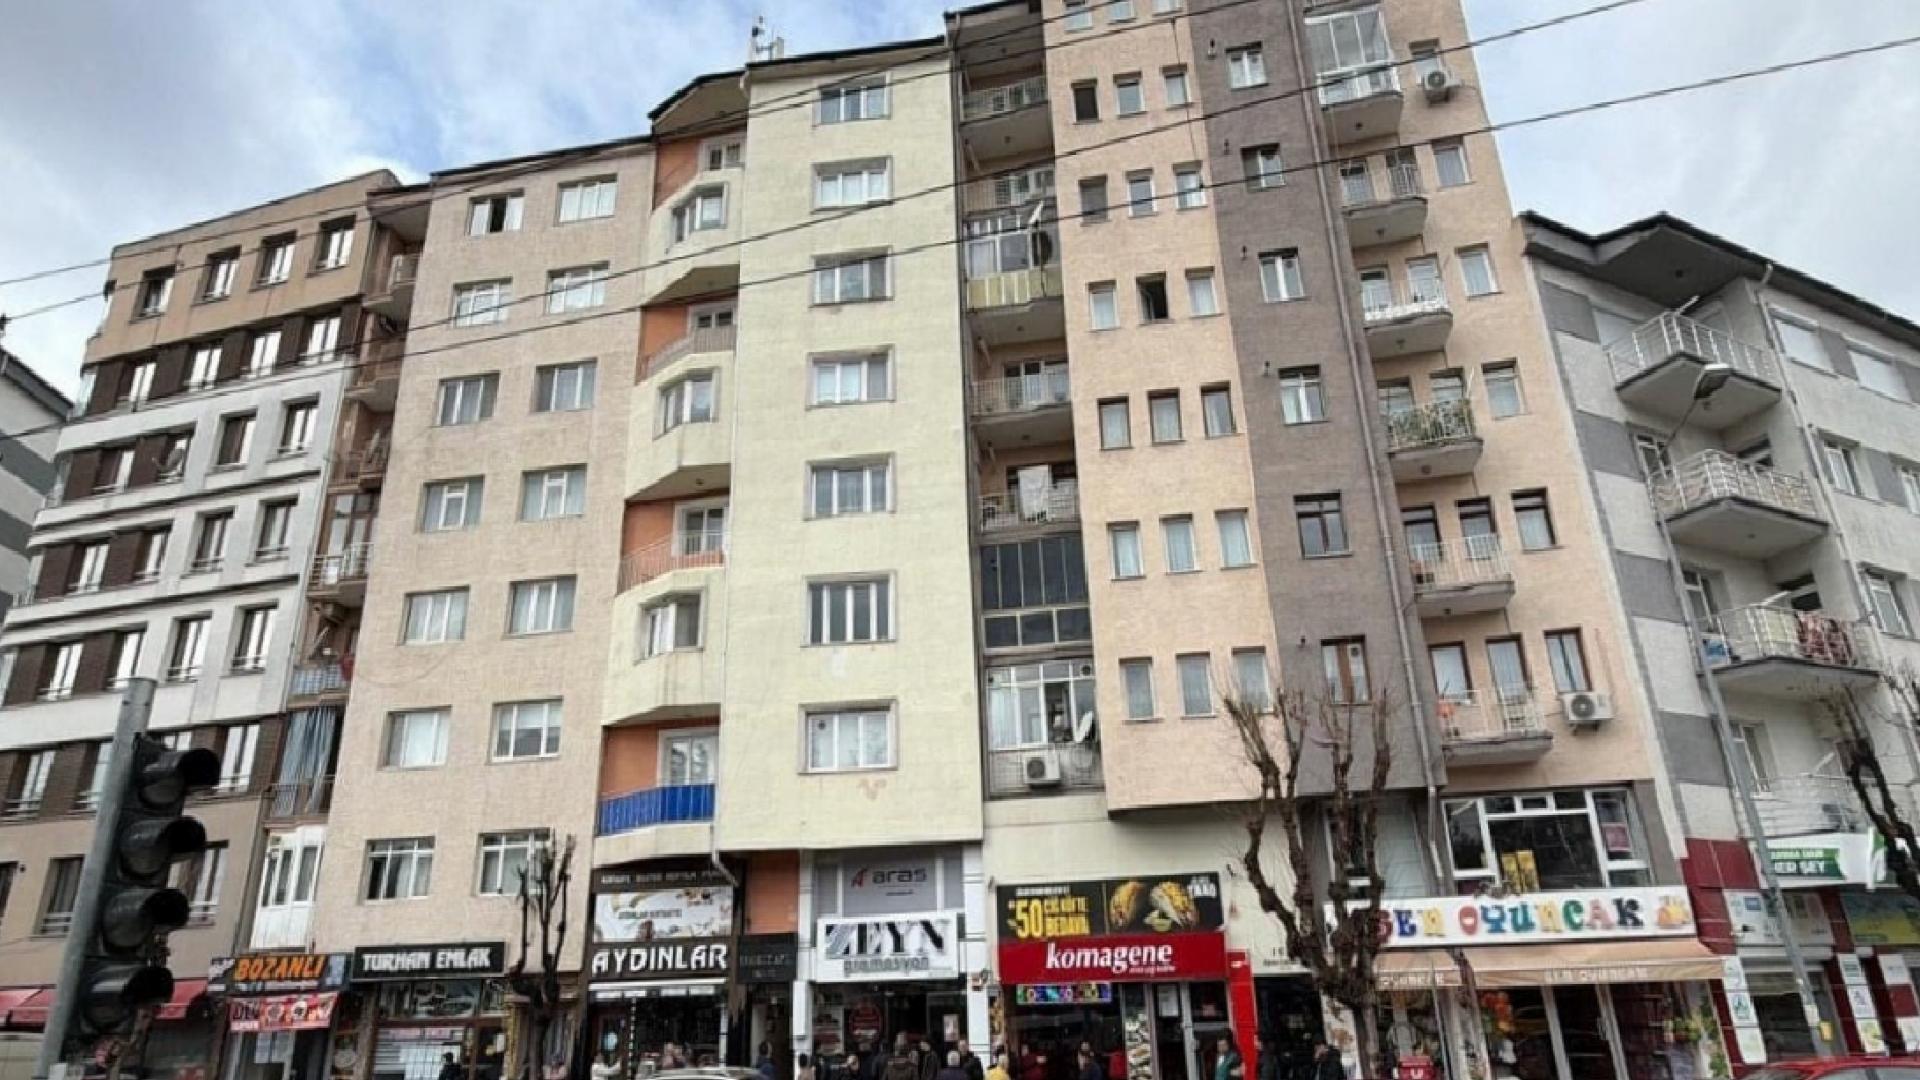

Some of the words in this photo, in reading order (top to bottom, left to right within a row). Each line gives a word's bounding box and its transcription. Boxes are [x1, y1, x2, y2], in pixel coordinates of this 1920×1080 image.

[872, 869, 928, 884] aras
[1458, 897, 1644, 936] OYUNCAK
[234, 954, 326, 980] BOZANLI
[436, 947, 491, 969] EMLAK
[591, 944, 727, 976] AYDINLAR
[1047, 943, 1173, 974] komagene
